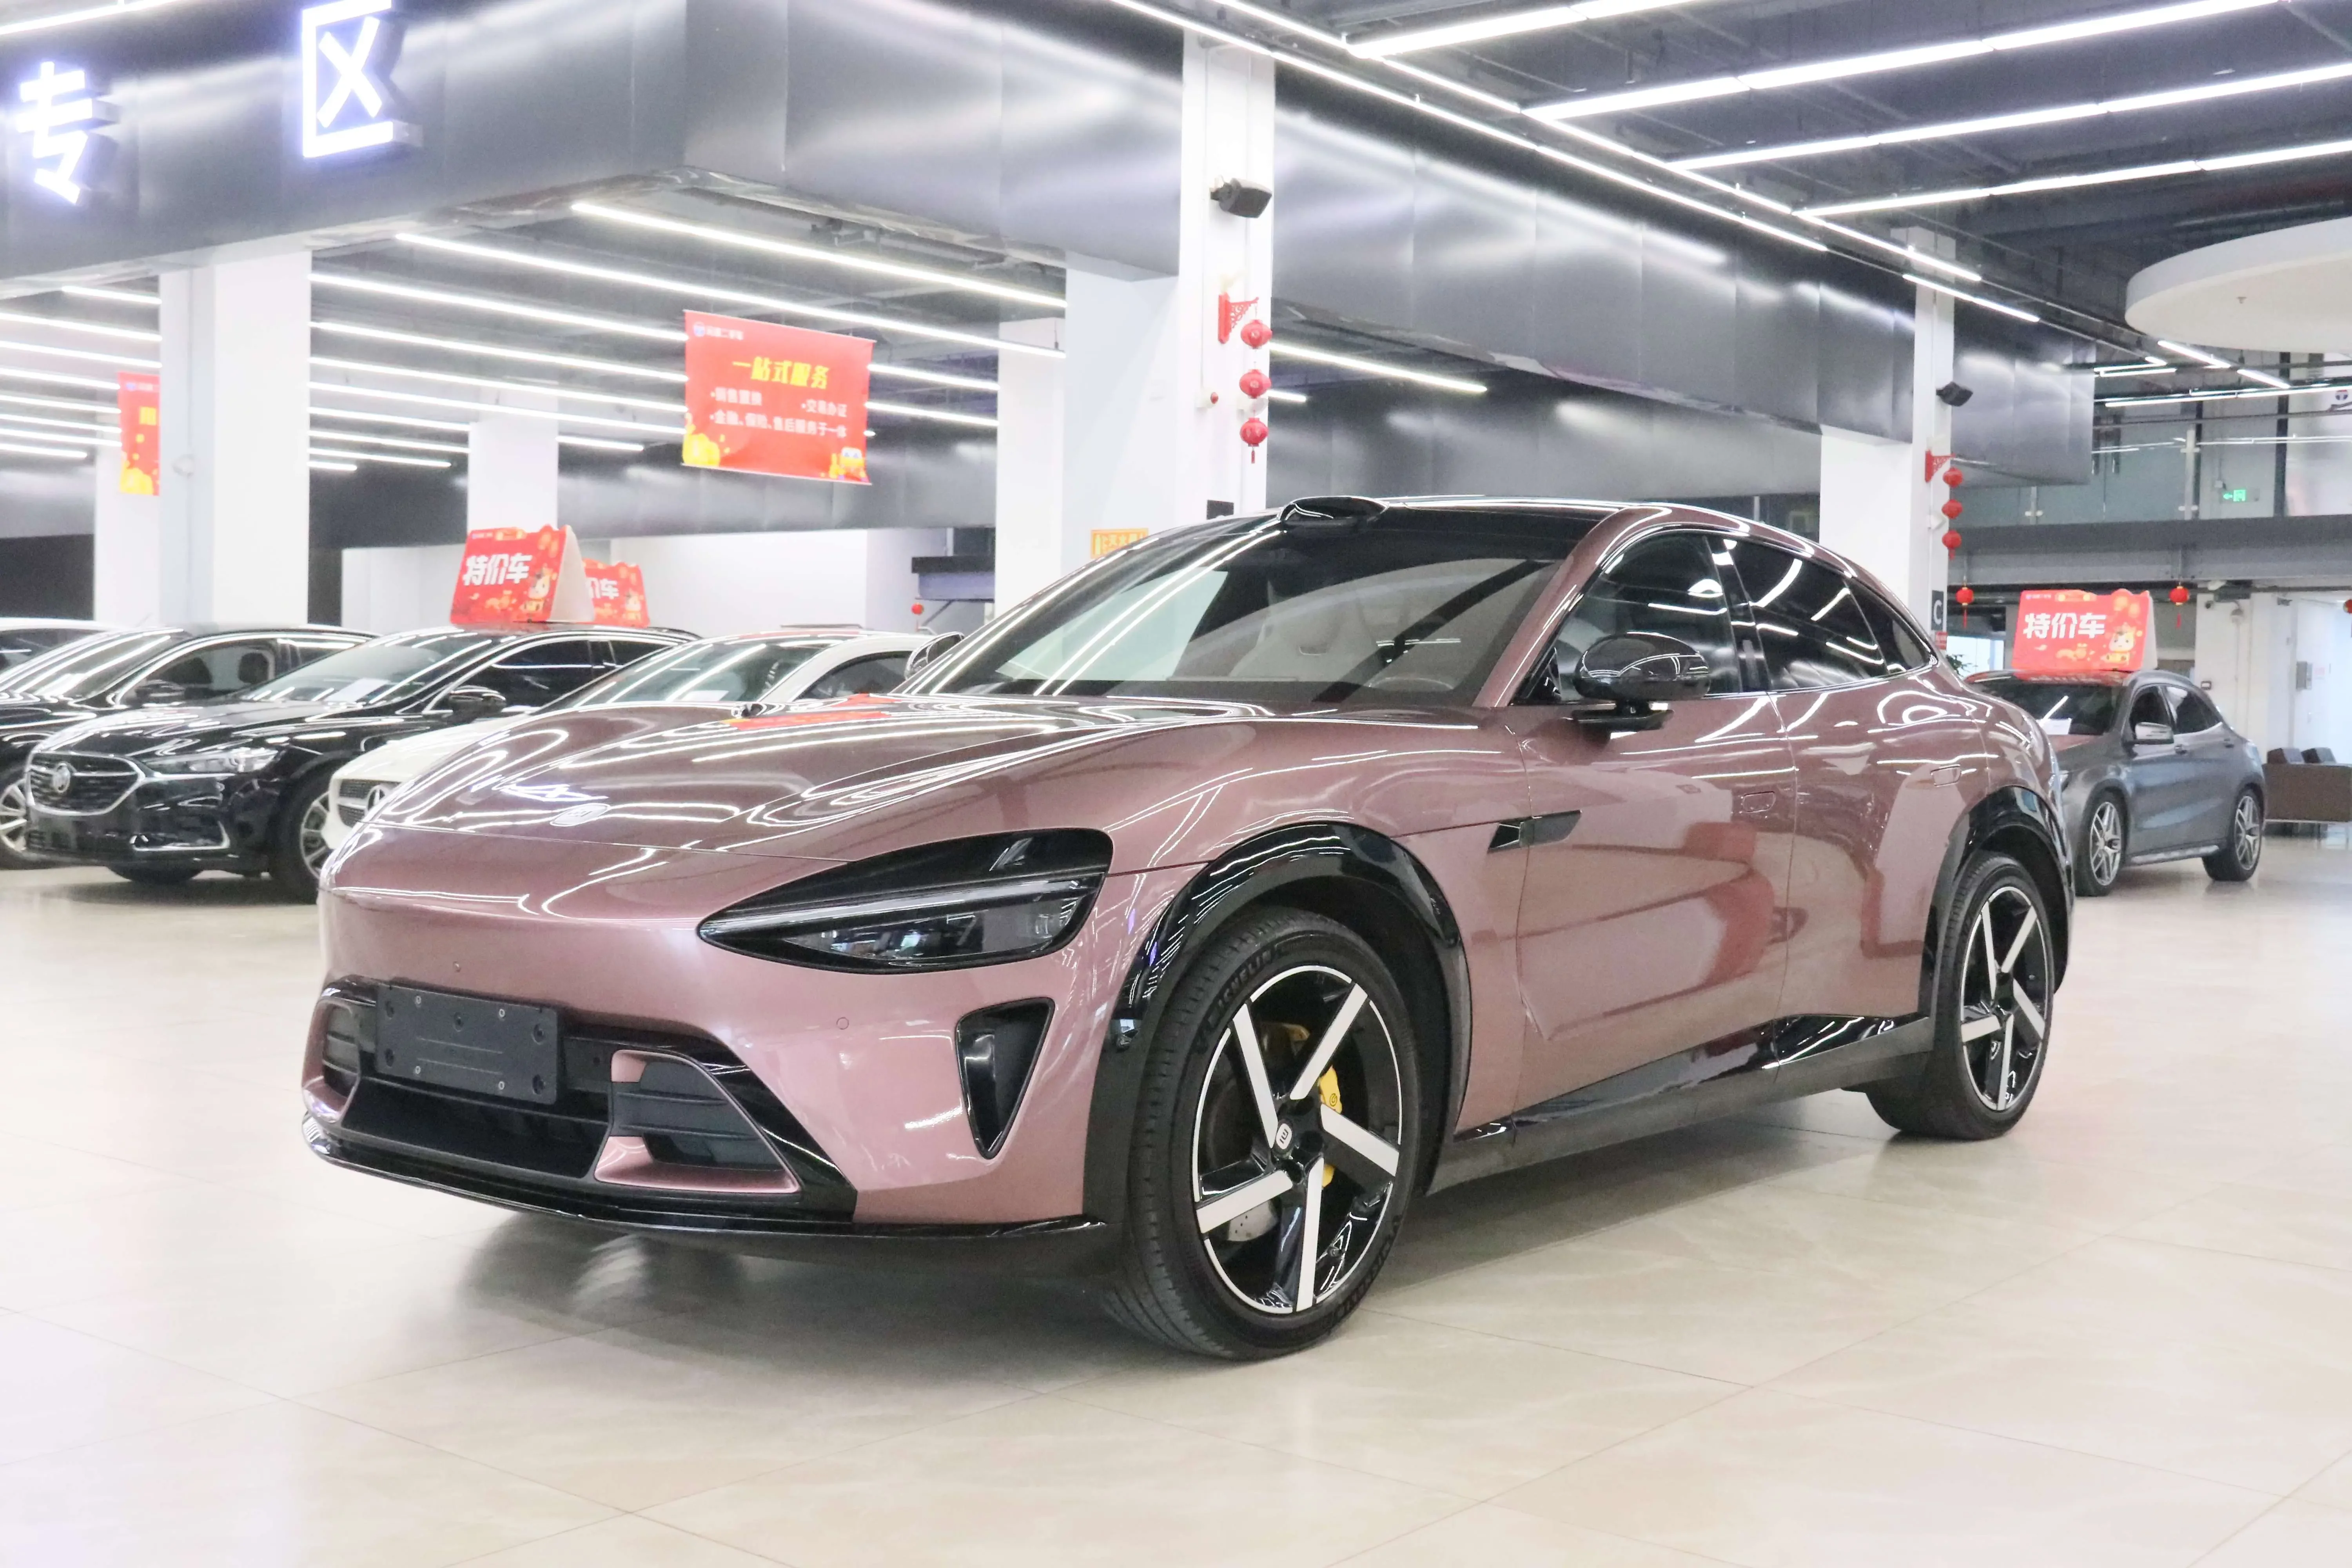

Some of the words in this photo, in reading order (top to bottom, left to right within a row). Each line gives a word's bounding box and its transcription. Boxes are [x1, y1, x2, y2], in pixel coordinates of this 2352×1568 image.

[732, 356, 829, 389] 一站式服务
[463, 553, 532, 586] 特价车
[1933, 600, 1942, 624] C
[2023, 612, 2107, 639] 特价车
